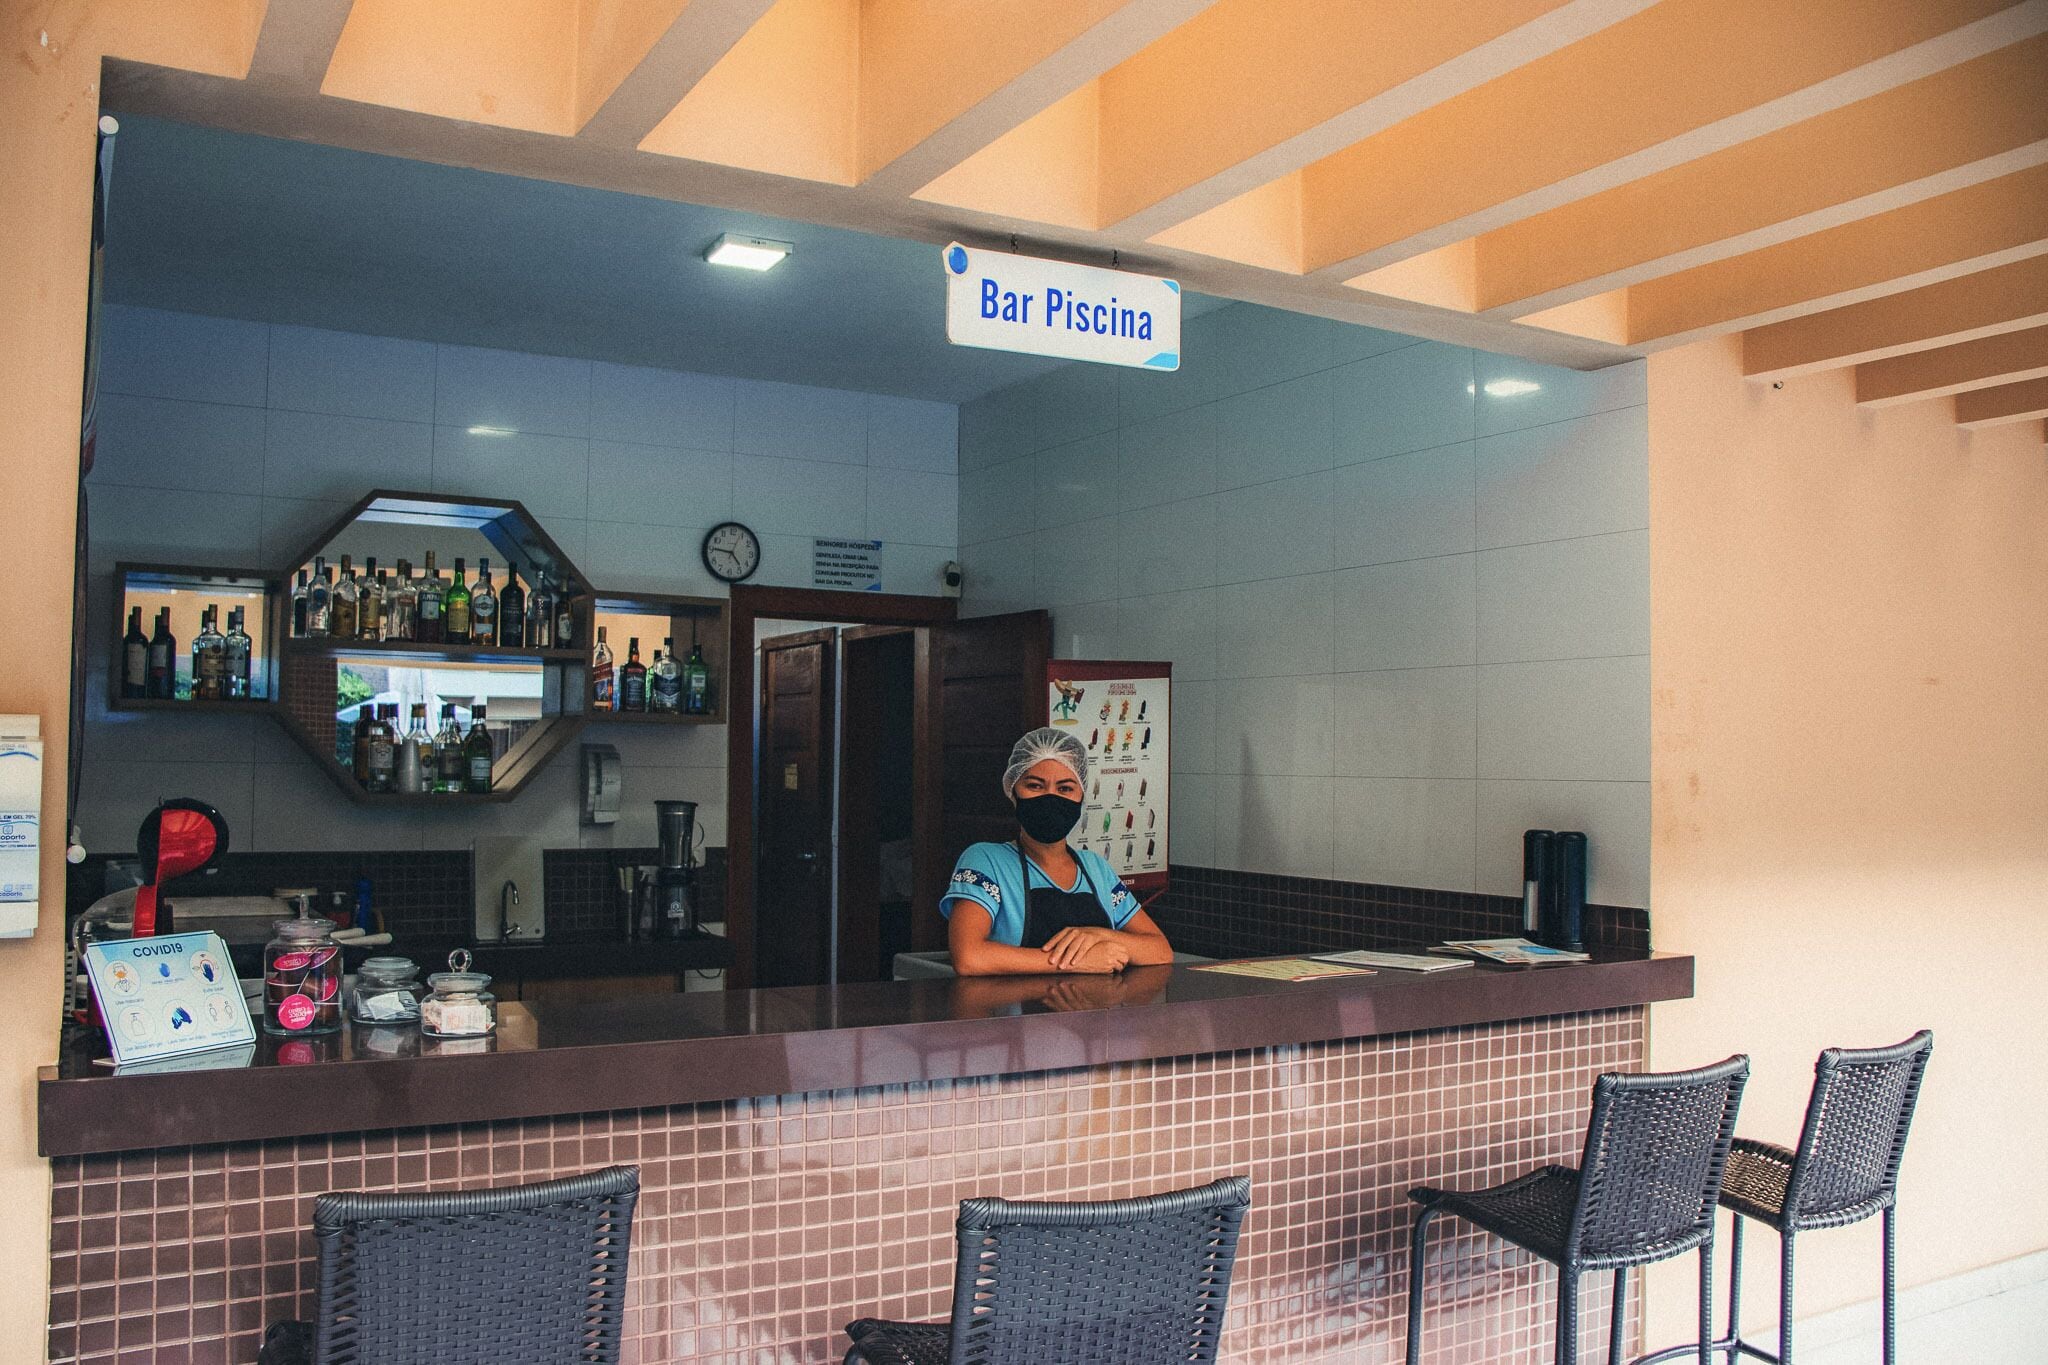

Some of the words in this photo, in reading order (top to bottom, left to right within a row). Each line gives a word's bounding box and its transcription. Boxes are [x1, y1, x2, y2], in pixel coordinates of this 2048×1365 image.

[981, 278, 1034, 324] Bar
[1046, 287, 1152, 341] Piscina
[816, 540, 848, 548] SENHORES
[132, 943, 183, 958] COVID19
